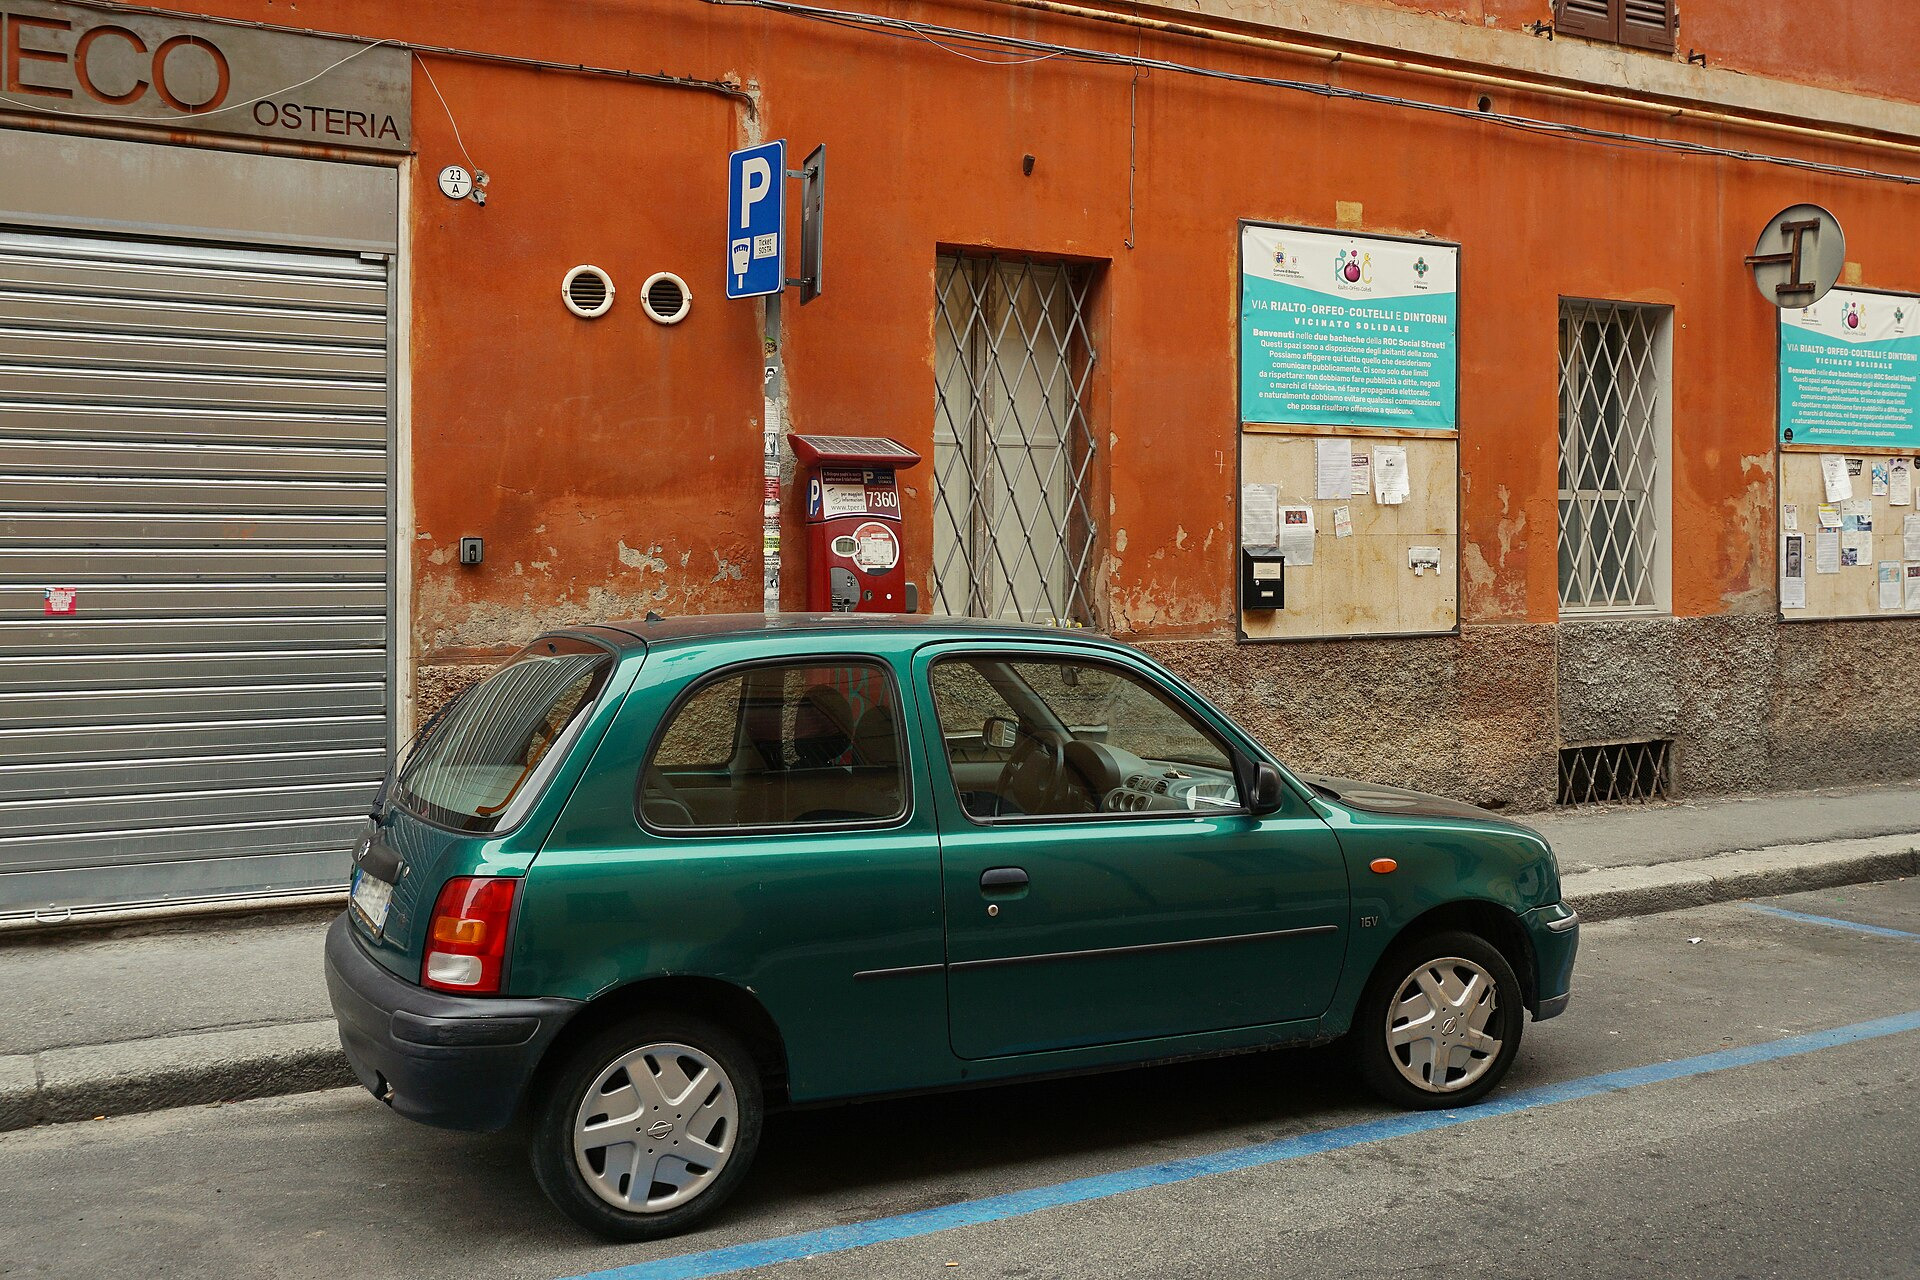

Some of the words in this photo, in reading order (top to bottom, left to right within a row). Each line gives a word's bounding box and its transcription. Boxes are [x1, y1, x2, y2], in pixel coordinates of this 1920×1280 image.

[0, 12, 230, 114] ECO
[253, 100, 400, 140] OSTERIA
[450, 170, 461, 180] 23
[452, 184, 459, 194] A
[740, 156, 771, 228] P
[758, 237, 772, 247] Ticket
[758, 246, 772, 254] SOSTA
[1252, 300, 1267, 309] VIA
[1271, 301, 1393, 319] RIALTO-ORFEO-COLTELLI
[1396, 312, 1401, 320] E
[1404, 312, 1446, 324] DINTORNI
[1295, 318, 1350, 328] VICINATO
[1356, 322, 1409, 333] SOLIDALE
[1253, 329, 1294, 338] Benvenuti
[1330, 334, 1365, 343] bacheche
[1325, 344, 1365, 353] disposizione
[1366, 347, 1381, 356] degli
[1800, 345, 1881, 358] RIALTO-ORFEO-COLTELLI
[1889, 352, 1917, 361] DINTORNI
[1270, 350, 1301, 359] Possiamo
[1302, 353, 1331, 362] affiggere
[1394, 359, 1431, 367] desideriamo
[1816, 358, 1853, 366] VICINATO
[1857, 361, 1892, 369] SOLIDALE
[1269, 371, 1304, 379] rispettare:
[1319, 374, 1350, 382] dobbiamo
[1264, 392, 1310, 400] naturalmente
[1351, 405, 1379, 413] offensiva
[864, 472, 874, 484] P
[810, 480, 820, 514] P
[866, 492, 896, 507] 7360
[1360, 916, 1379, 928] 16V
